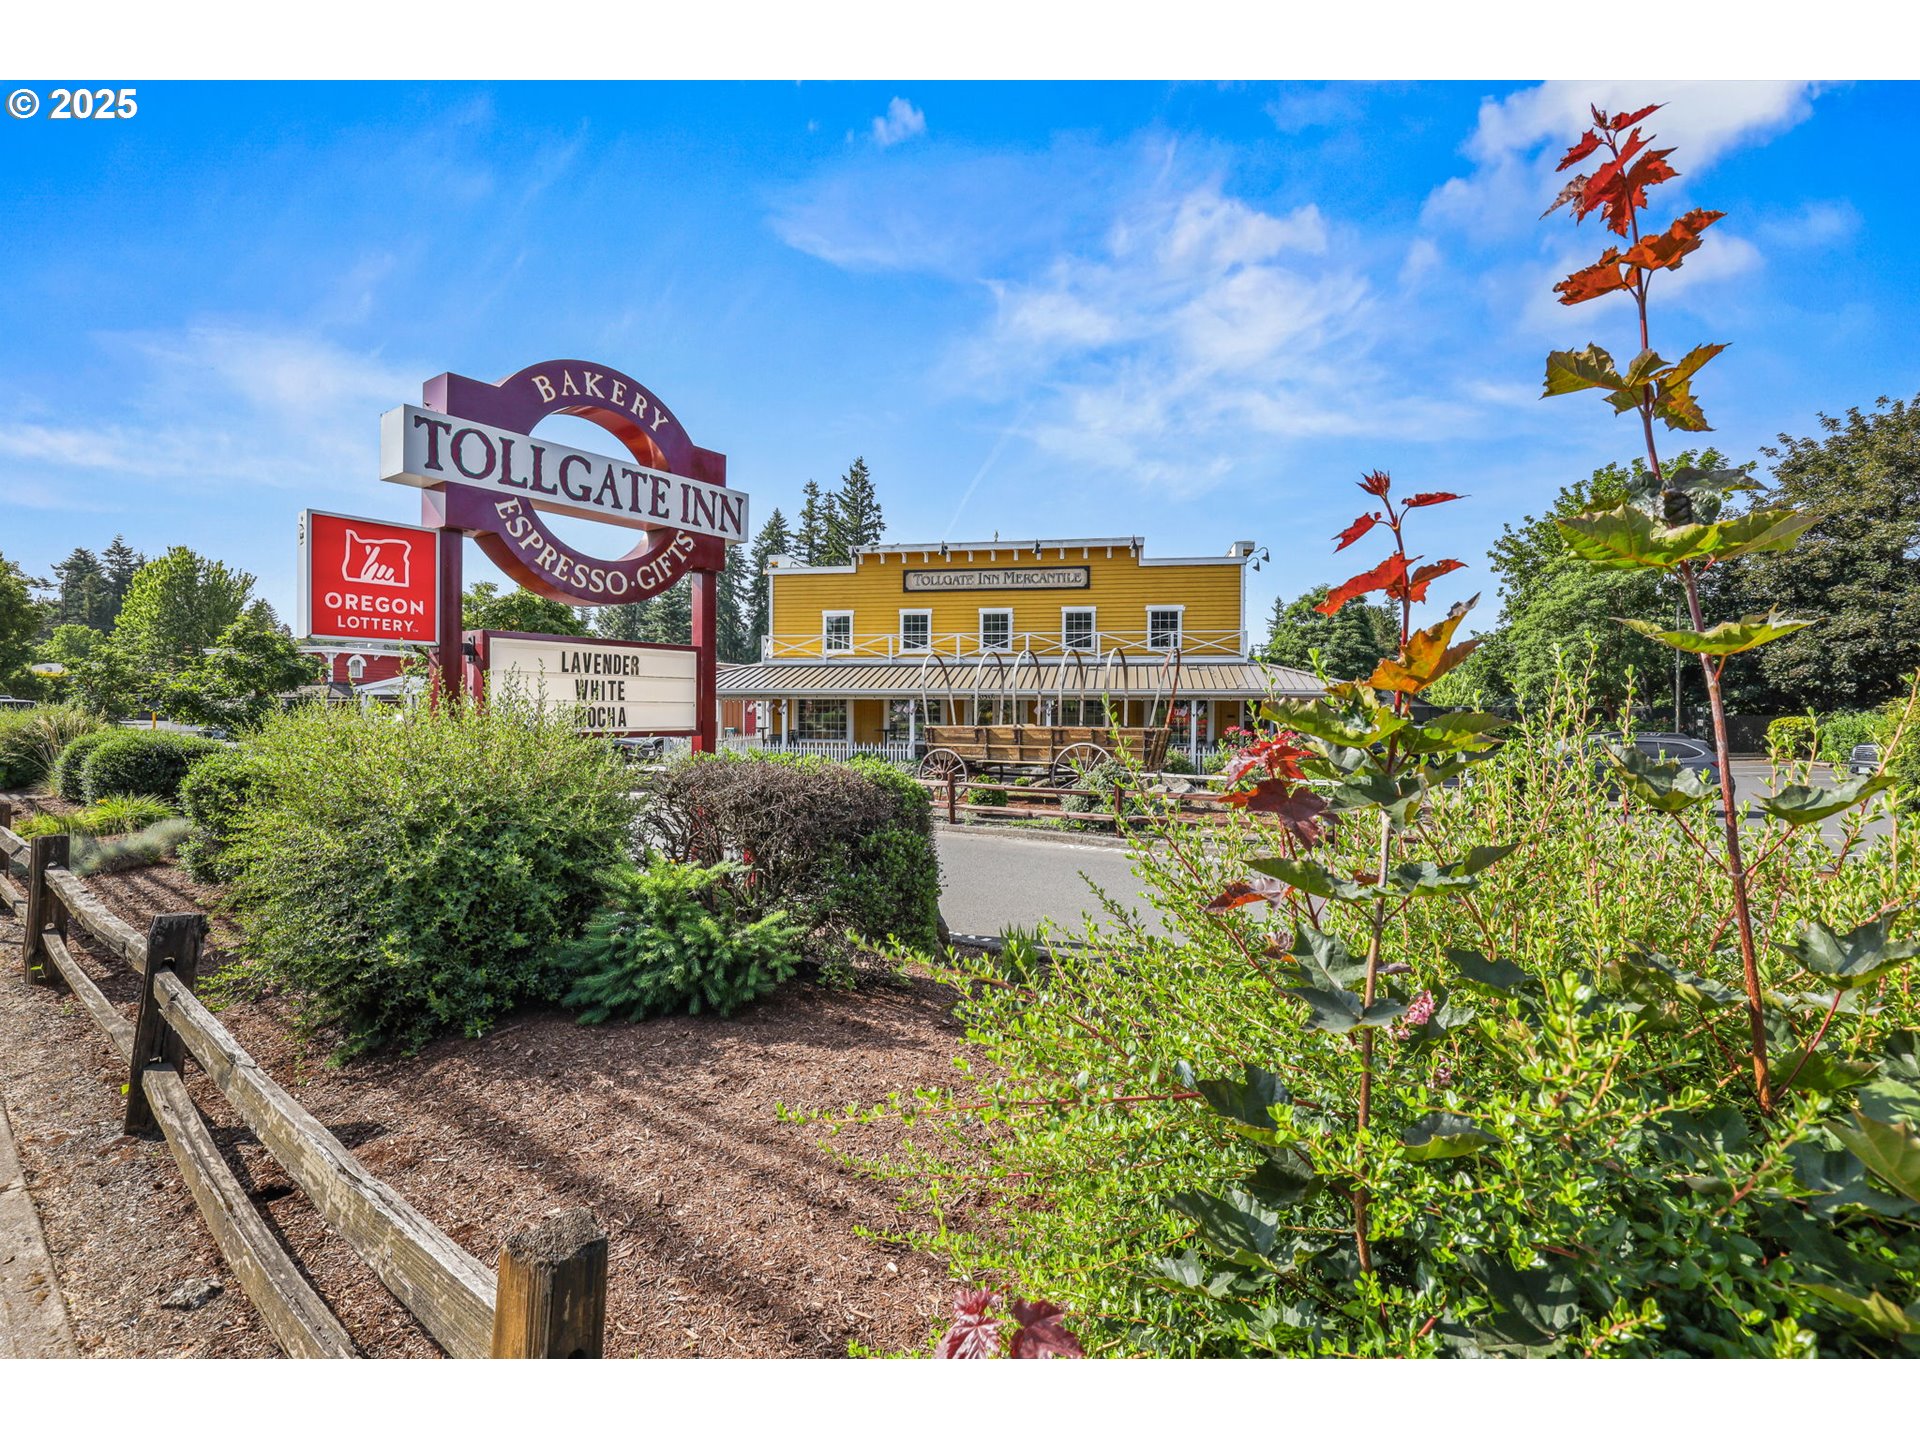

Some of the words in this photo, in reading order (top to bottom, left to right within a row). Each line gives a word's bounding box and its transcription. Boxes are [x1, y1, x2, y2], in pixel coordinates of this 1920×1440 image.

[531, 369, 669, 432] BAKERY
[414, 415, 671, 519] TOLLGATE
[680, 483, 744, 535] INN
[494, 497, 628, 595] ESPRESSO
[636, 530, 694, 590] GIFTS
[324, 591, 425, 616] OREGON
[561, 651, 640, 676] LAVENDER
[575, 679, 626, 701] WHITE
